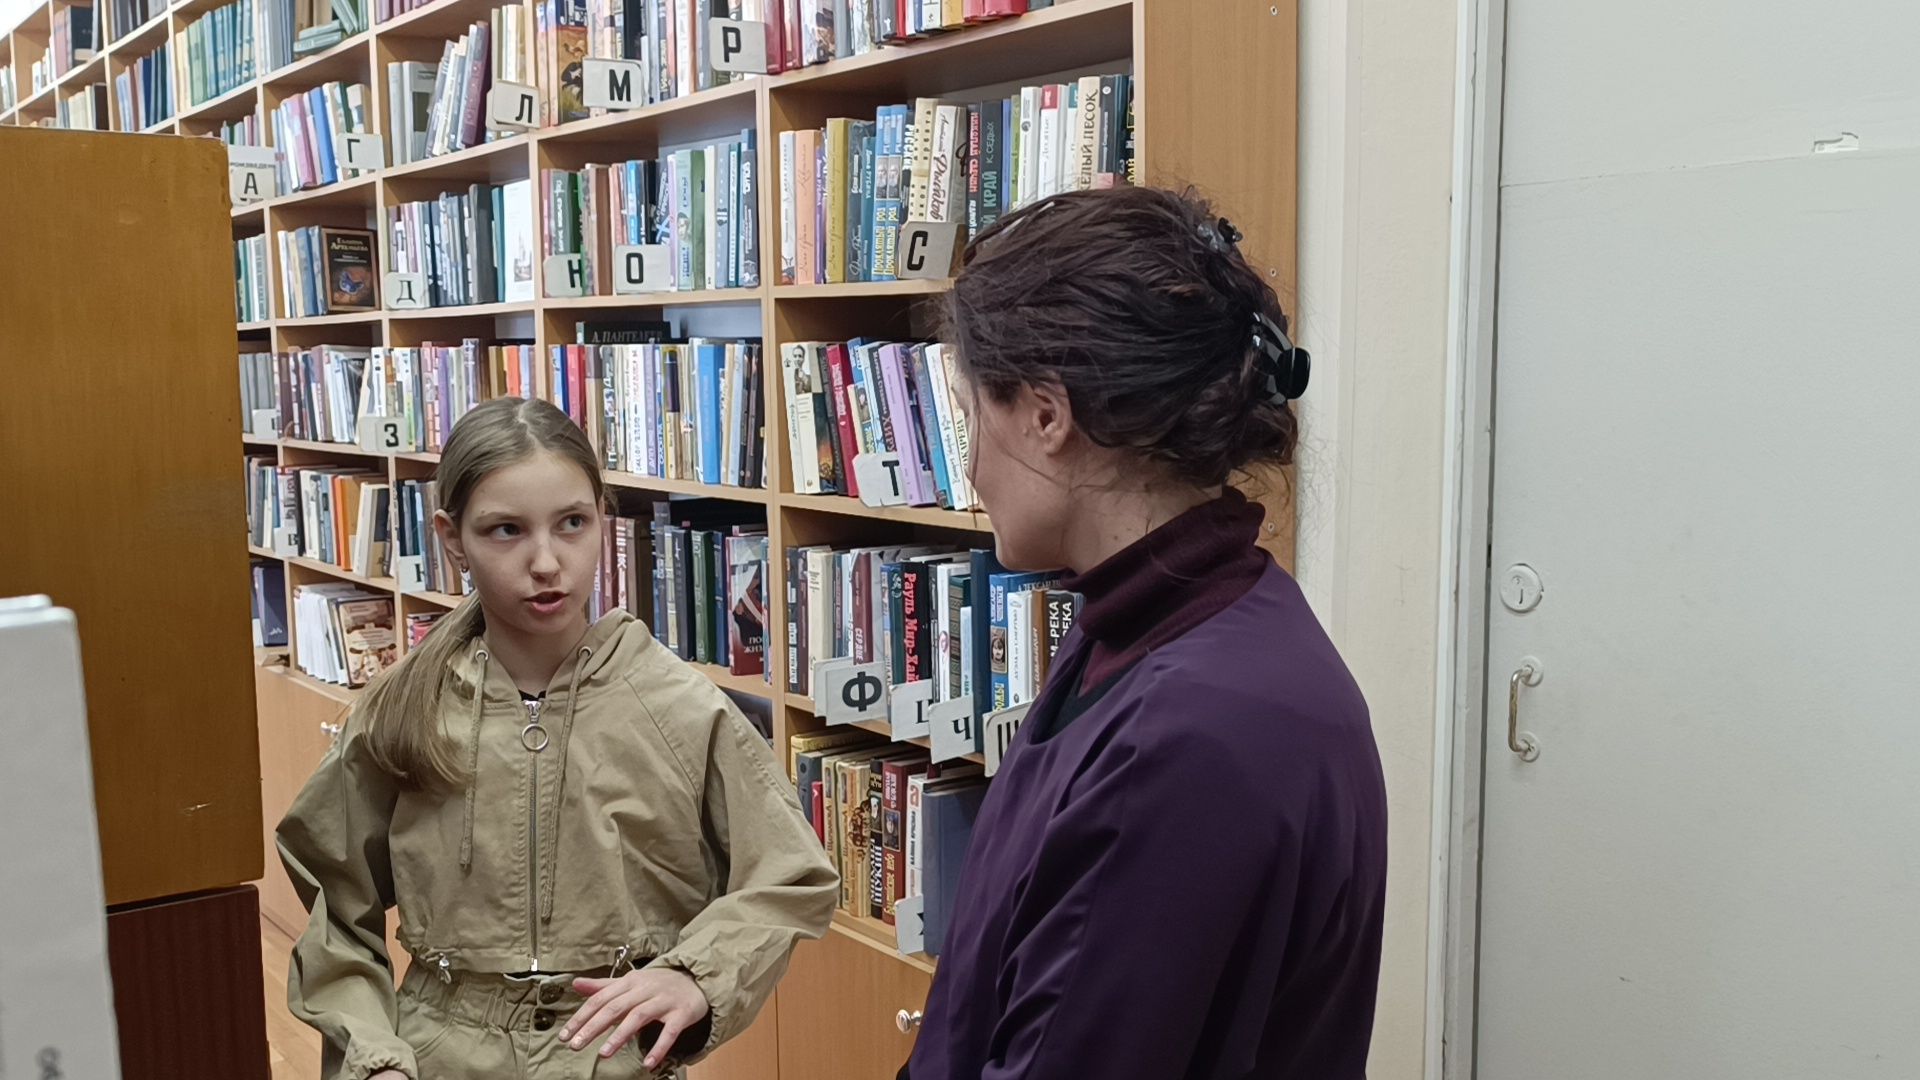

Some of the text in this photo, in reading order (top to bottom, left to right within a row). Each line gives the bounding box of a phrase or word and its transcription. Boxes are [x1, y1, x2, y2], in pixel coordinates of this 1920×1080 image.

[722, 26, 742, 63] Р
[608, 68, 632, 103] М
[515, 93, 534, 124] Л
[1083, 89, 1099, 141] ПЕСОК
[346, 138, 360, 163] Г
[969, 112, 980, 156] НИКОЛАЙ
[985, 121, 995, 154] СЕДЫХ
[243, 172, 259, 195] А
[930, 154, 948, 222] Рыбаков
[982, 170, 998, 208] КРАЙ
[873, 207, 886, 275] Проклятый род
[884, 206, 898, 275] Проклятый род
[906, 230, 929, 271] С
[567, 258, 582, 289] Н
[625, 252, 644, 285] О
[396, 280, 417, 305] Д
[881, 416, 897, 453] ХИРУ
[954, 418, 968, 468] ОКАРЕВА
[881, 459, 900, 497] Т
[854, 627, 864, 661] СЕРДЦЕ
[903, 572, 920, 684] Рауль Мир-Хай
[1049, 601, 1060, 658] М-РЕКА
[841, 671, 883, 712] Ф
[952, 715, 973, 741] Ч
[873, 845, 882, 904] ЩУКИН
